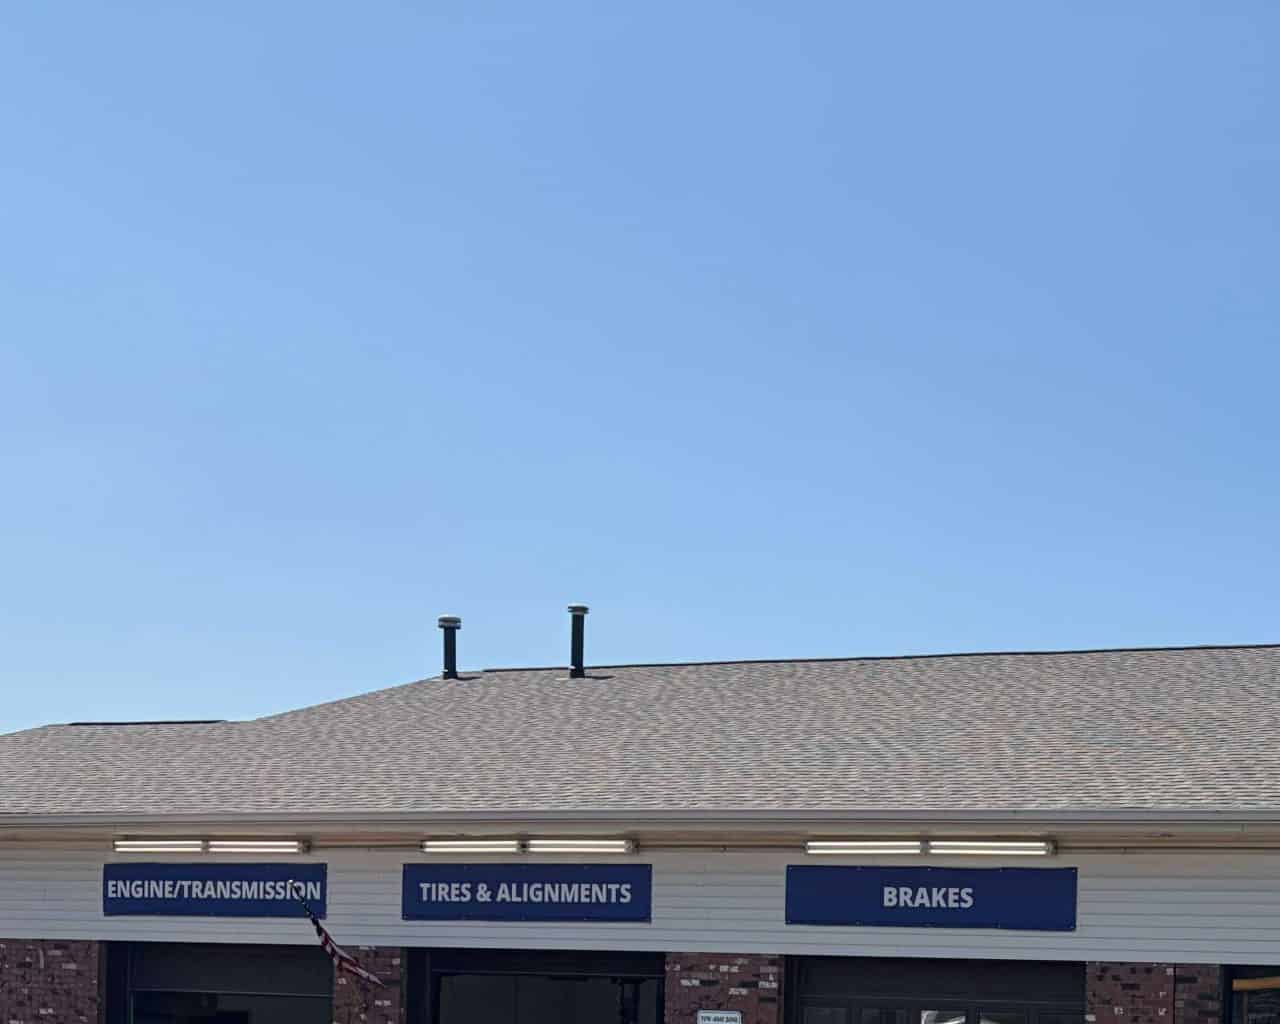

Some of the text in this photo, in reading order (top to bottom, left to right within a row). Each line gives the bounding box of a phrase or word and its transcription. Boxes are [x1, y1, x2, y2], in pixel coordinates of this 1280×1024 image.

[108, 880, 321, 900] ENGINE/TRANSMISSION
[419, 883, 631, 903] TIRES & ALIGNMENTS
[882, 887, 973, 908] BRAKES
